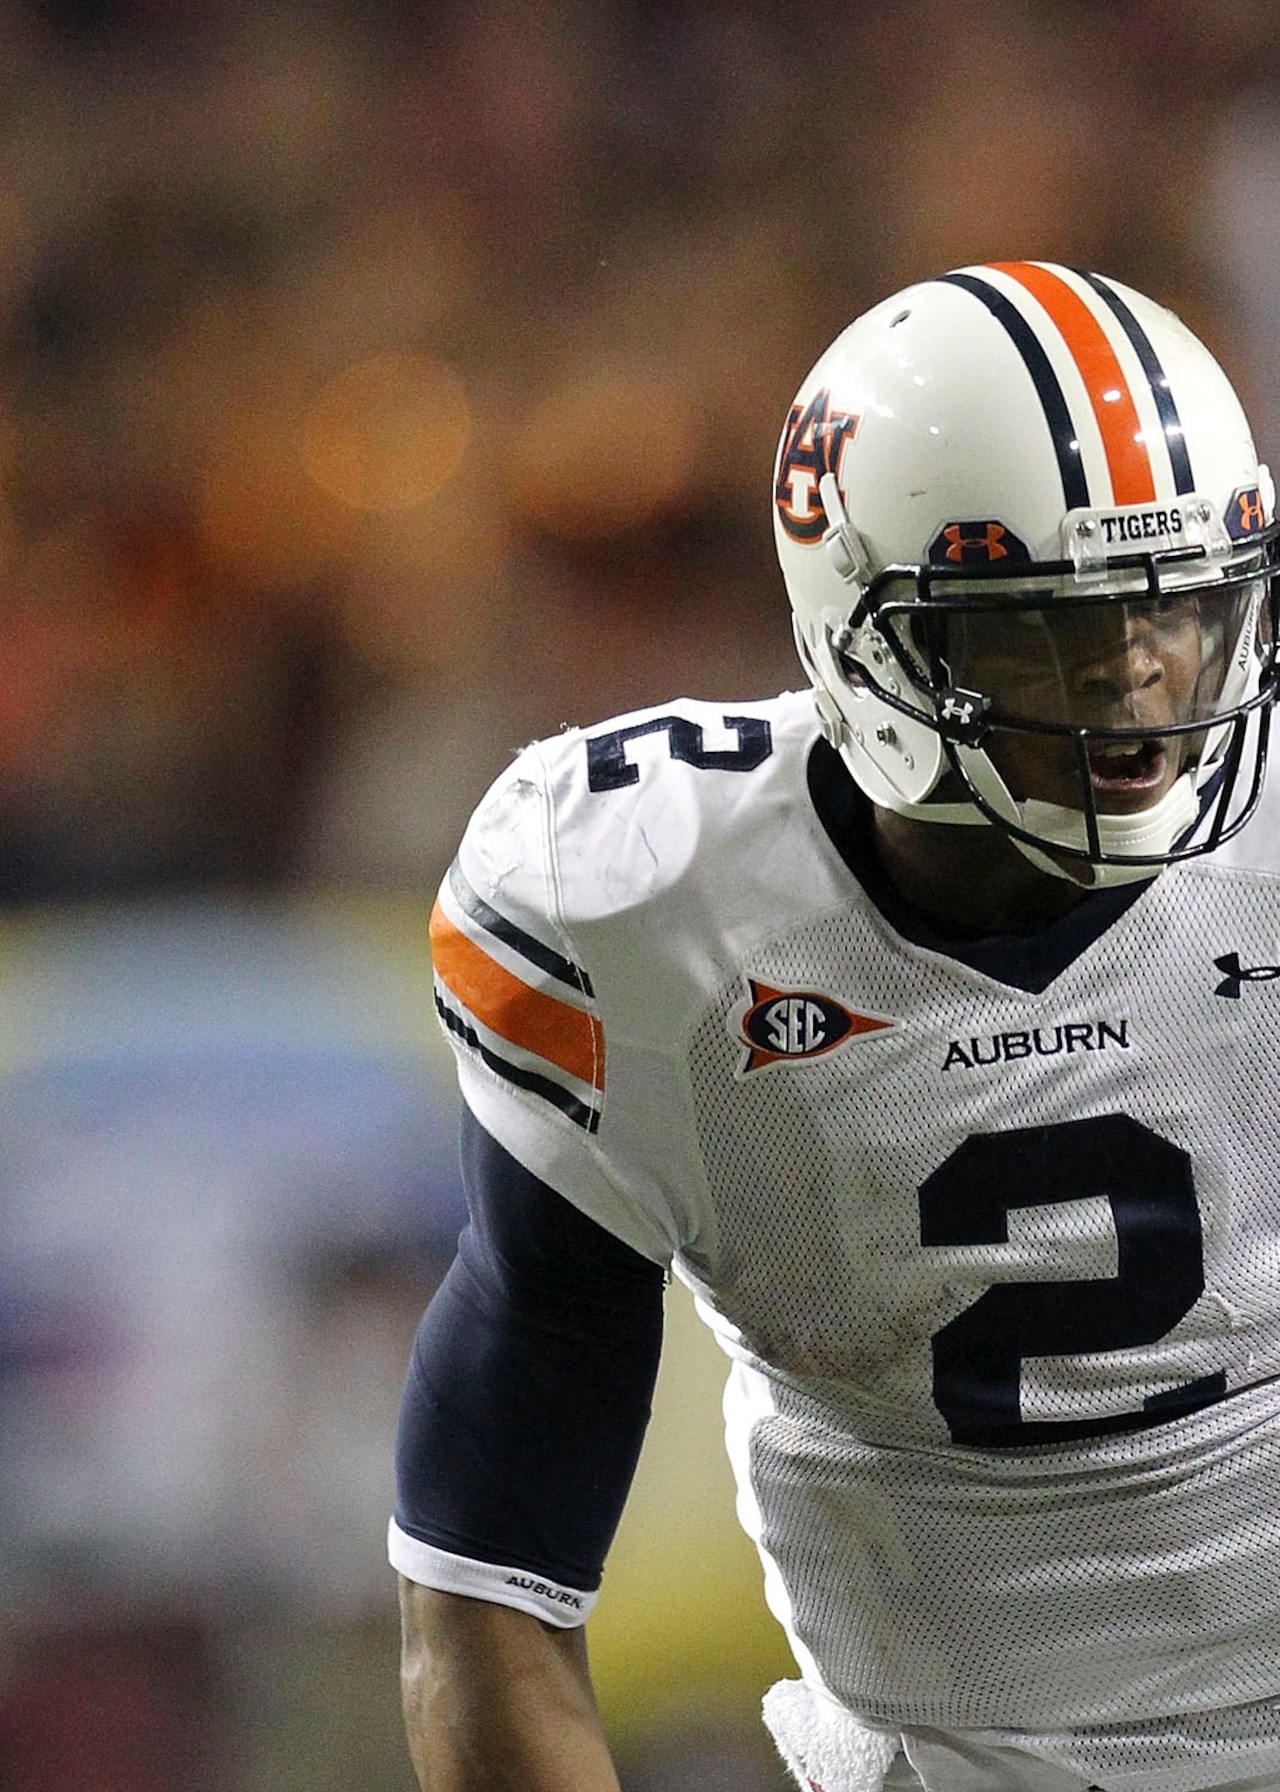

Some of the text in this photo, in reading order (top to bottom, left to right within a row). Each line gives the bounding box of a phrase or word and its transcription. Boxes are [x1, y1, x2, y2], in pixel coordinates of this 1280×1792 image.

[1100, 508, 1182, 543] TIGERS
[586, 715, 773, 793] 2
[765, 999, 826, 1053] SEC
[941, 1020, 1130, 1071] AUBURN
[918, 1112, 1228, 1448] 2
[505, 1576, 580, 1609] AUBURN
